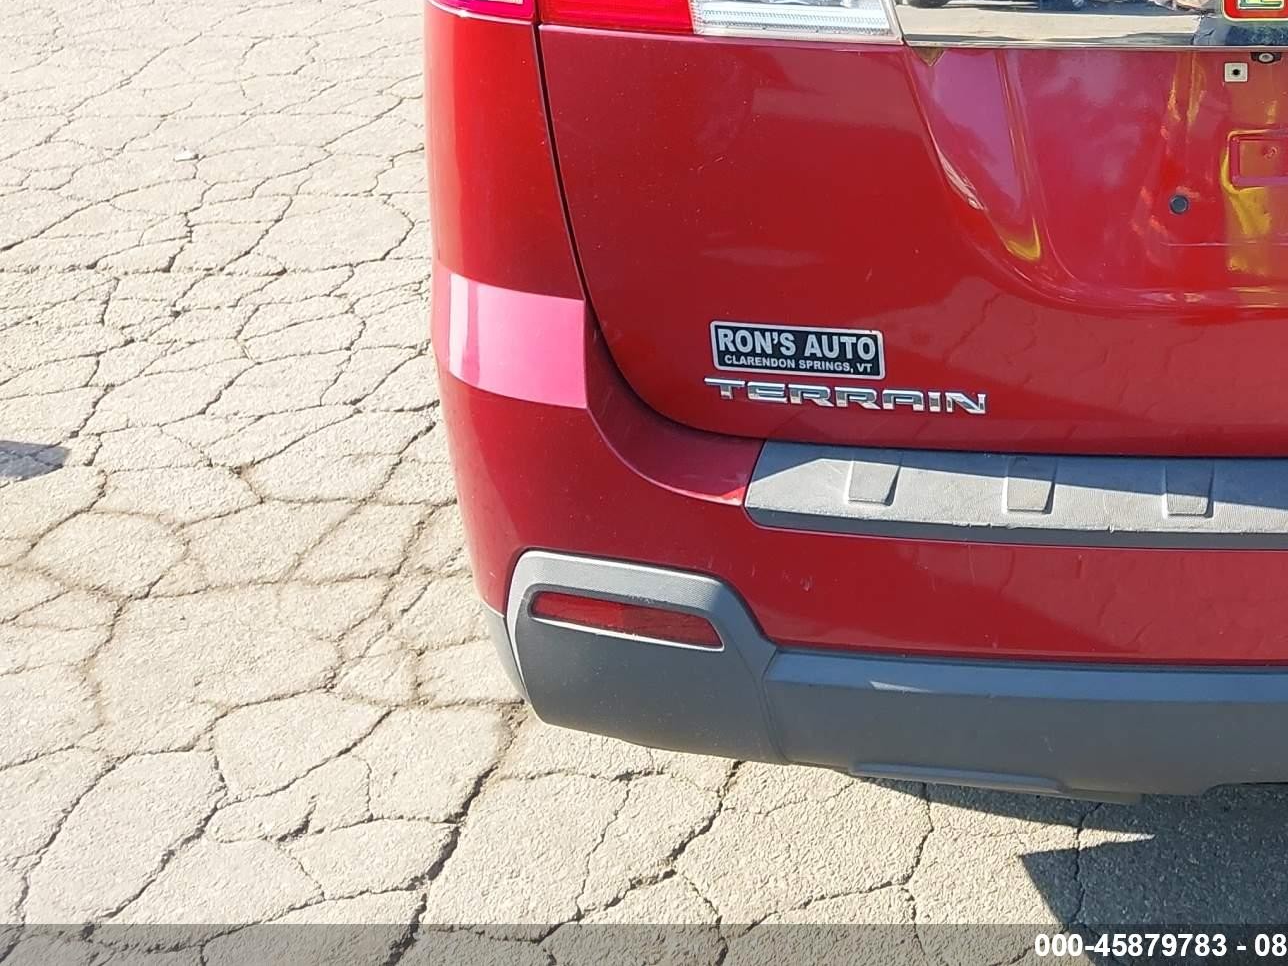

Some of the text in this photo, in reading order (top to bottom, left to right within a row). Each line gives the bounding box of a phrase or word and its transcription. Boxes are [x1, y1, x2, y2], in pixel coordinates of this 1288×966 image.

[717, 328, 876, 361] RON'S AUTO
[724, 354, 873, 373] CLARENDON SPRINGS, VT
[704, 377, 987, 415] TERRAIN
